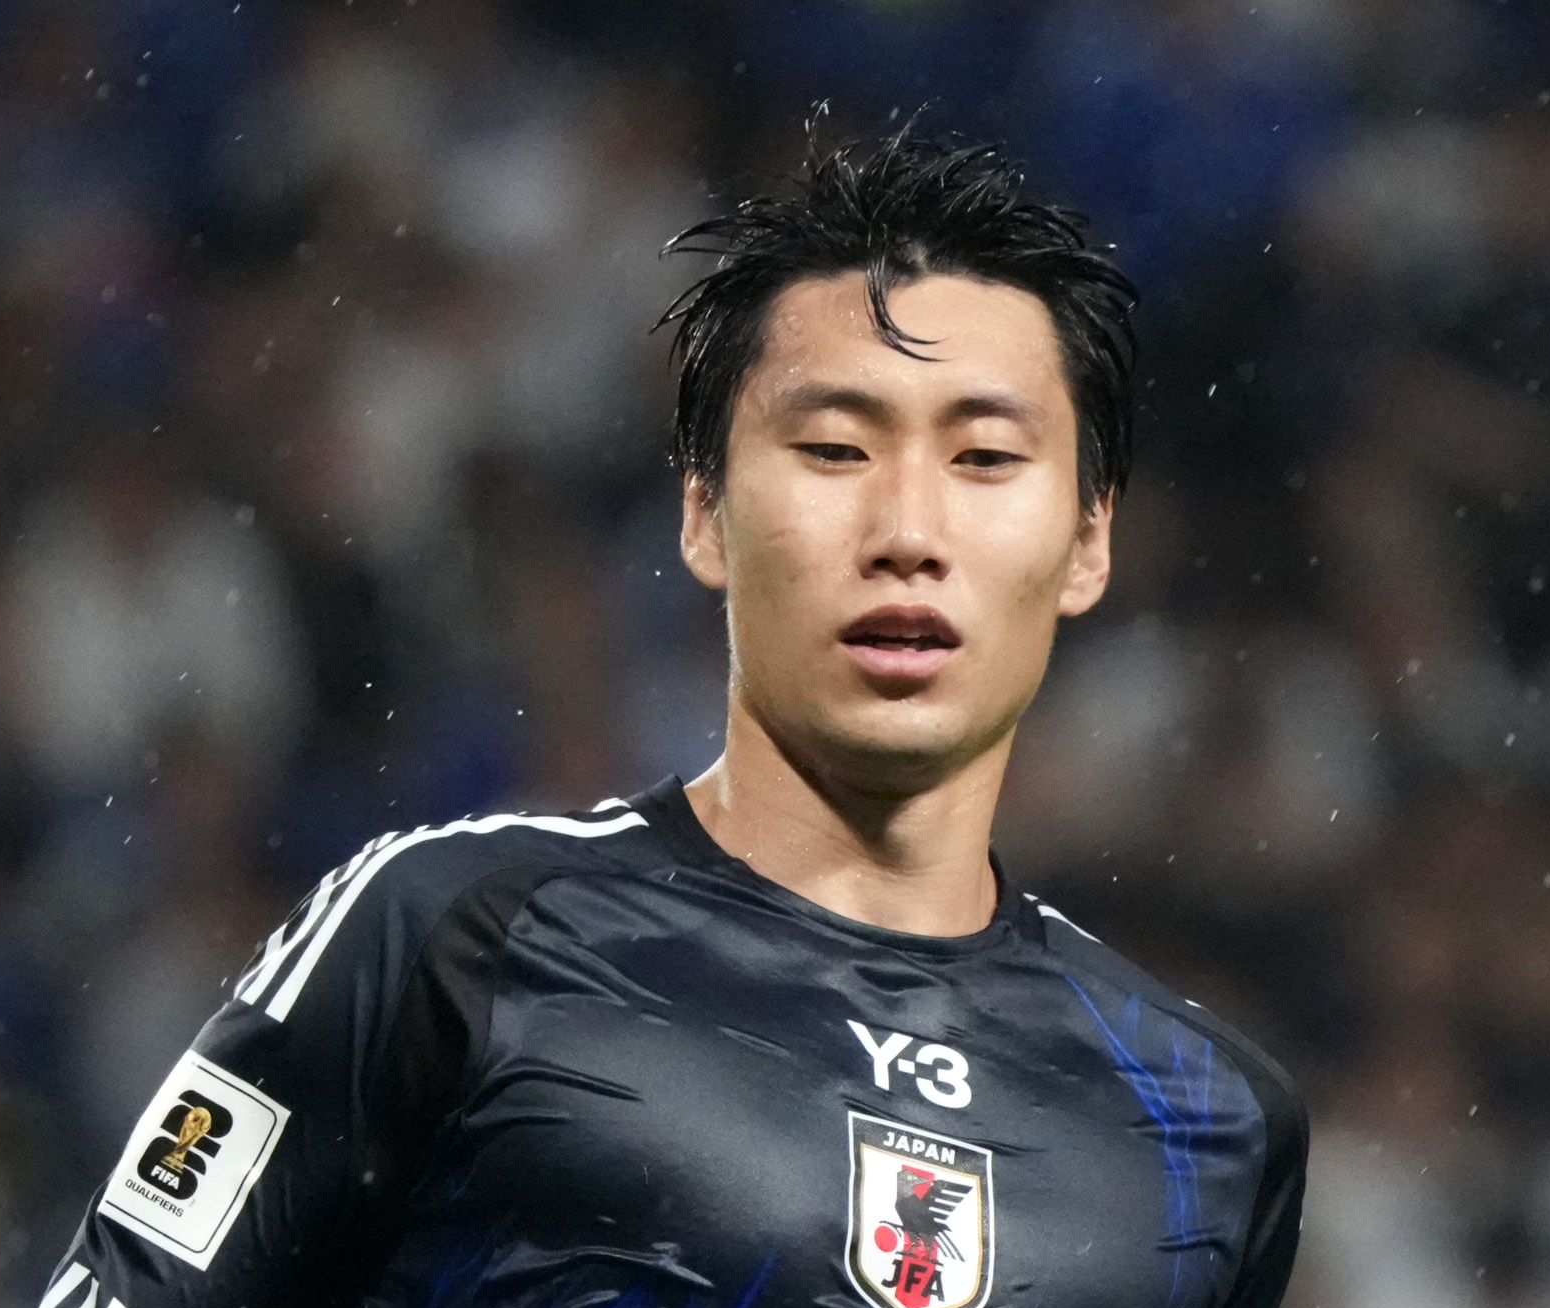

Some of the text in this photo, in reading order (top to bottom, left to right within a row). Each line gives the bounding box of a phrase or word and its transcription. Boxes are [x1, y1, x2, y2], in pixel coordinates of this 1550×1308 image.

[847, 1019, 972, 1109] Y-3
[883, 1131, 956, 1165] JAPAN
[151, 1165, 180, 1190] FIFA
[125, 1179, 184, 1217] QUALIFIERS
[881, 1259, 945, 1302] JFA
